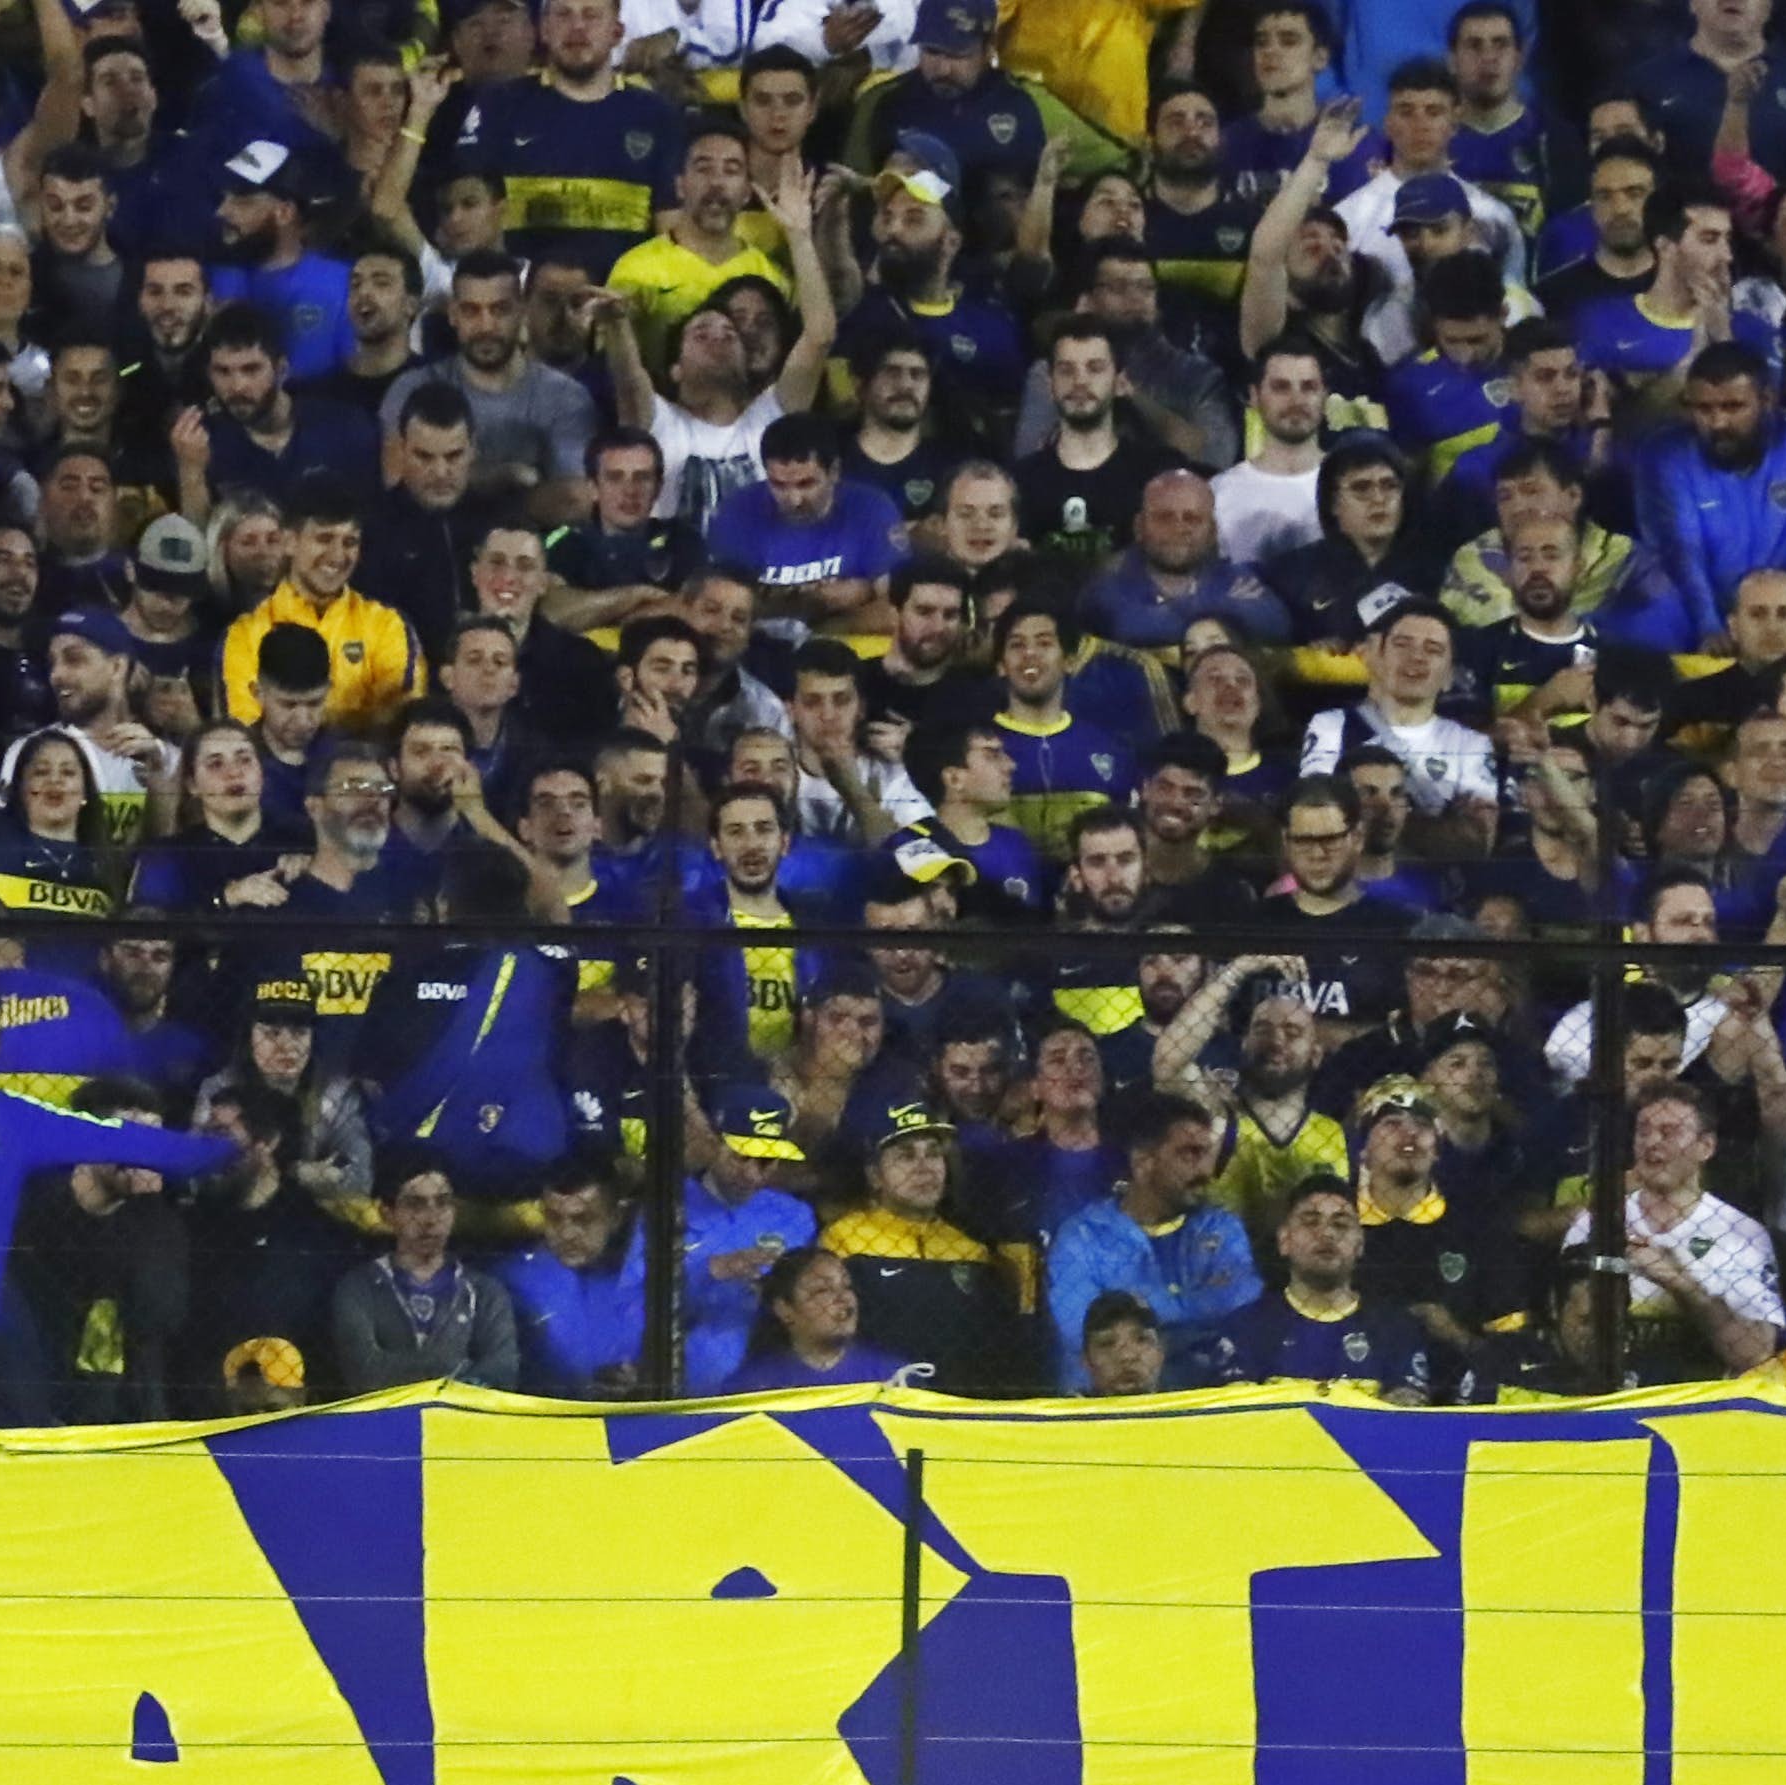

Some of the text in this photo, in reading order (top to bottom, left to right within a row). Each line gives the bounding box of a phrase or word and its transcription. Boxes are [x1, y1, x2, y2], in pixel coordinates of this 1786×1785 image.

[27, 882, 108, 913] BBVA
[256, 980, 311, 1002] BOCA
[305, 969, 383, 1001] BBV
[417, 982, 468, 1001] BBVA
